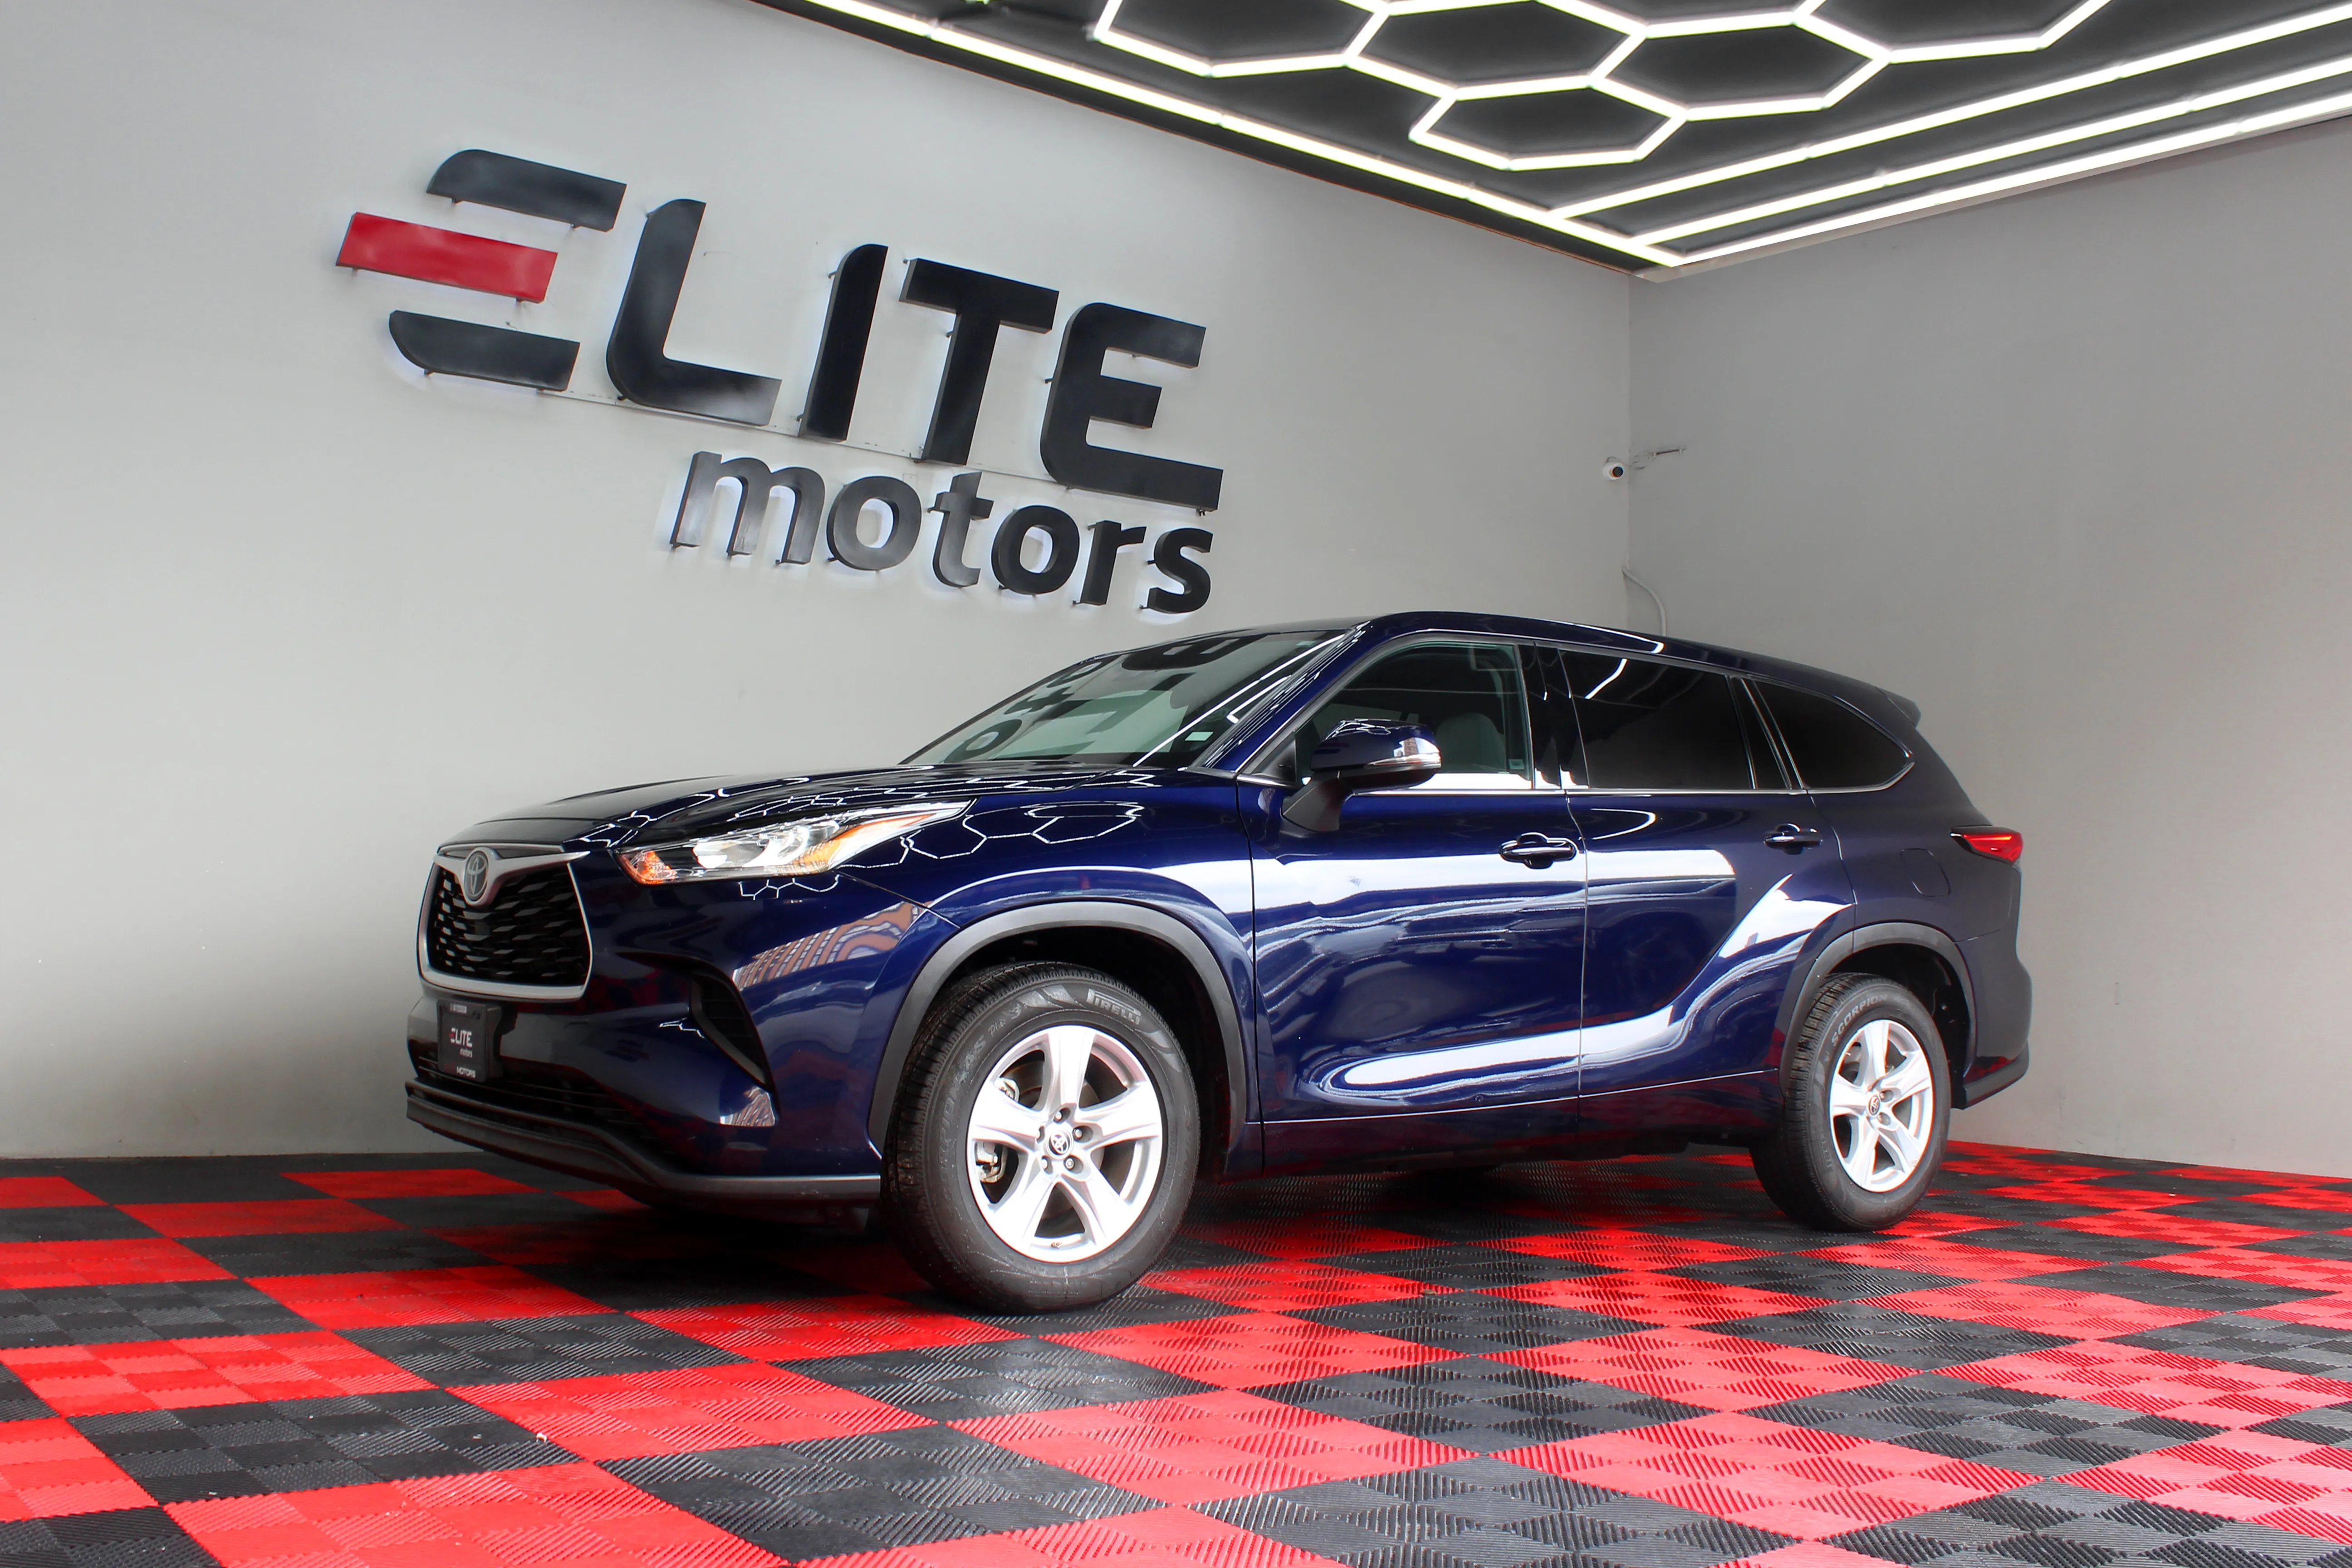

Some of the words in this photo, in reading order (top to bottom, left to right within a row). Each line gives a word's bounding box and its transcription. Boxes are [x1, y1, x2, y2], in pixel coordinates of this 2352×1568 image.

[336, 149, 1224, 512] ELITE
[671, 451, 1213, 615] motors
[1086, 988, 1142, 1025] PIRELLI
[1832, 995, 1887, 1047] SCORPION
[449, 1028, 472, 1048] ELITE
[456, 1066, 475, 1078] MOTORS
